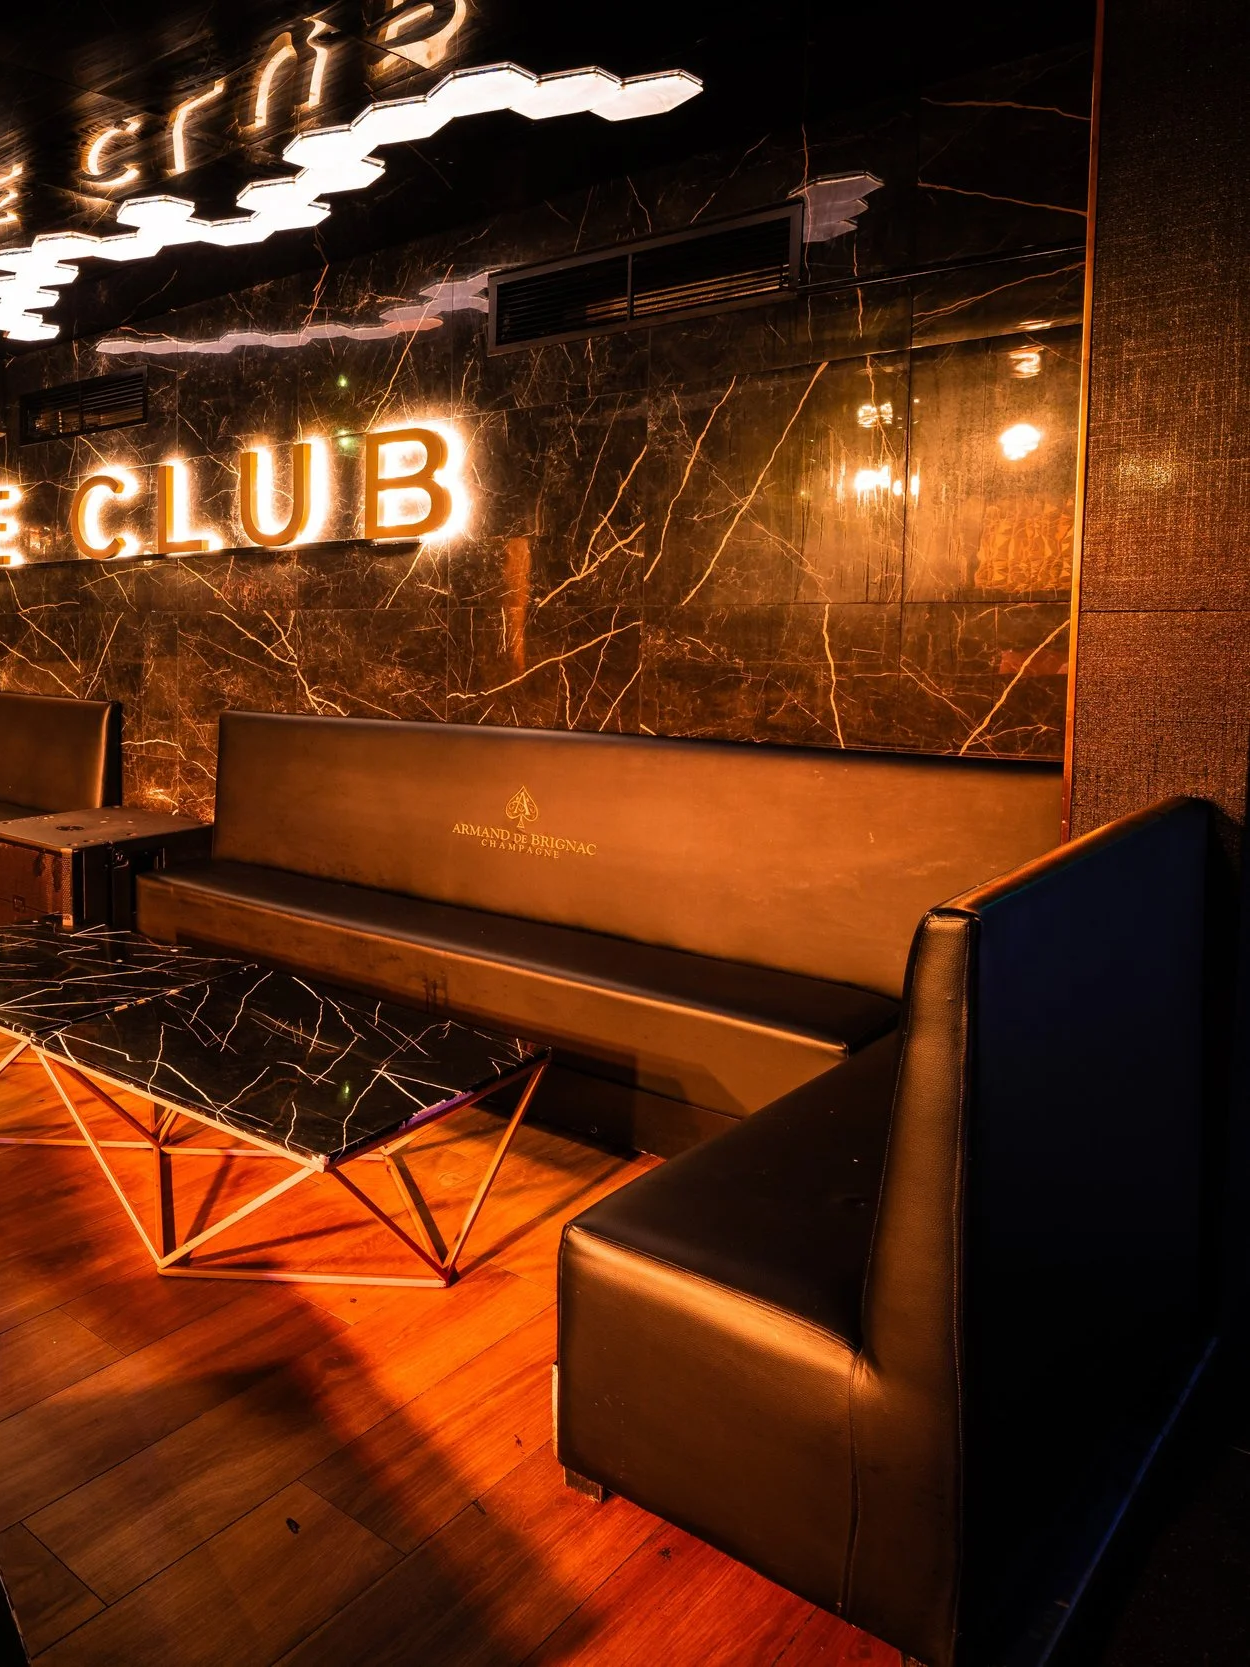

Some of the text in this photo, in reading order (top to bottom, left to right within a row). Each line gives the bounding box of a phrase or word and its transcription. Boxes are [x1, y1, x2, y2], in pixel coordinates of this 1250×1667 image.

[70, 426, 456, 561] CLUB
[452, 823, 597, 856] ARMAND DE BRIGNAC
[481, 838, 560, 859] CHAMPAGNE
